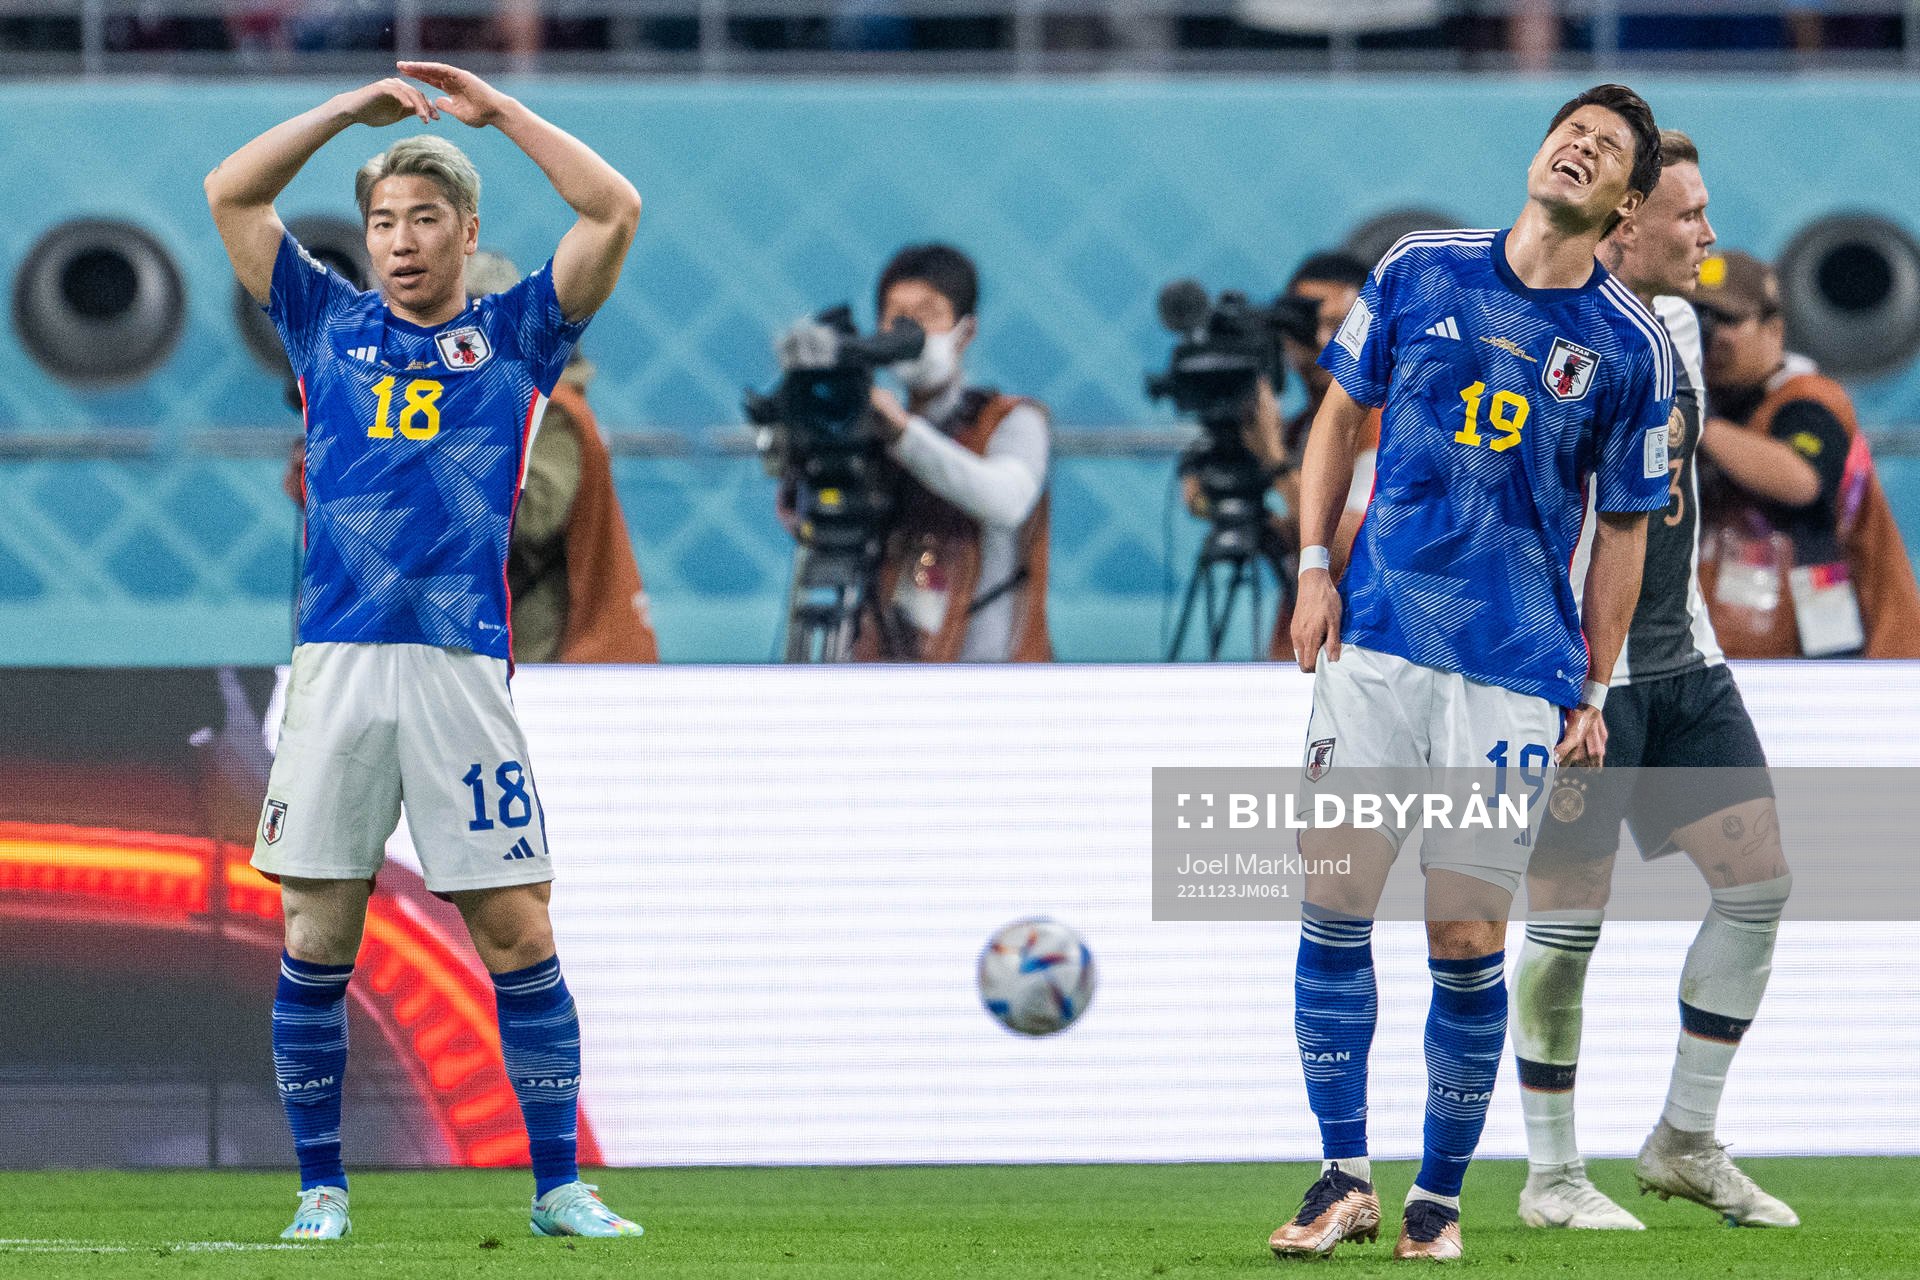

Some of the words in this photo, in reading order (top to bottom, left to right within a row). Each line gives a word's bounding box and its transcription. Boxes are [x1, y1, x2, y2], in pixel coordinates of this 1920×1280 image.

[1566, 343, 1590, 357] JAPAN
[367, 376, 444, 440] 18
[1454, 380, 1530, 452] 19
[1664, 458, 1684, 526] 3
[462, 760, 532, 831] 18
[1486, 741, 1549, 812] 19
[1300, 1050, 1350, 1062] PAN
